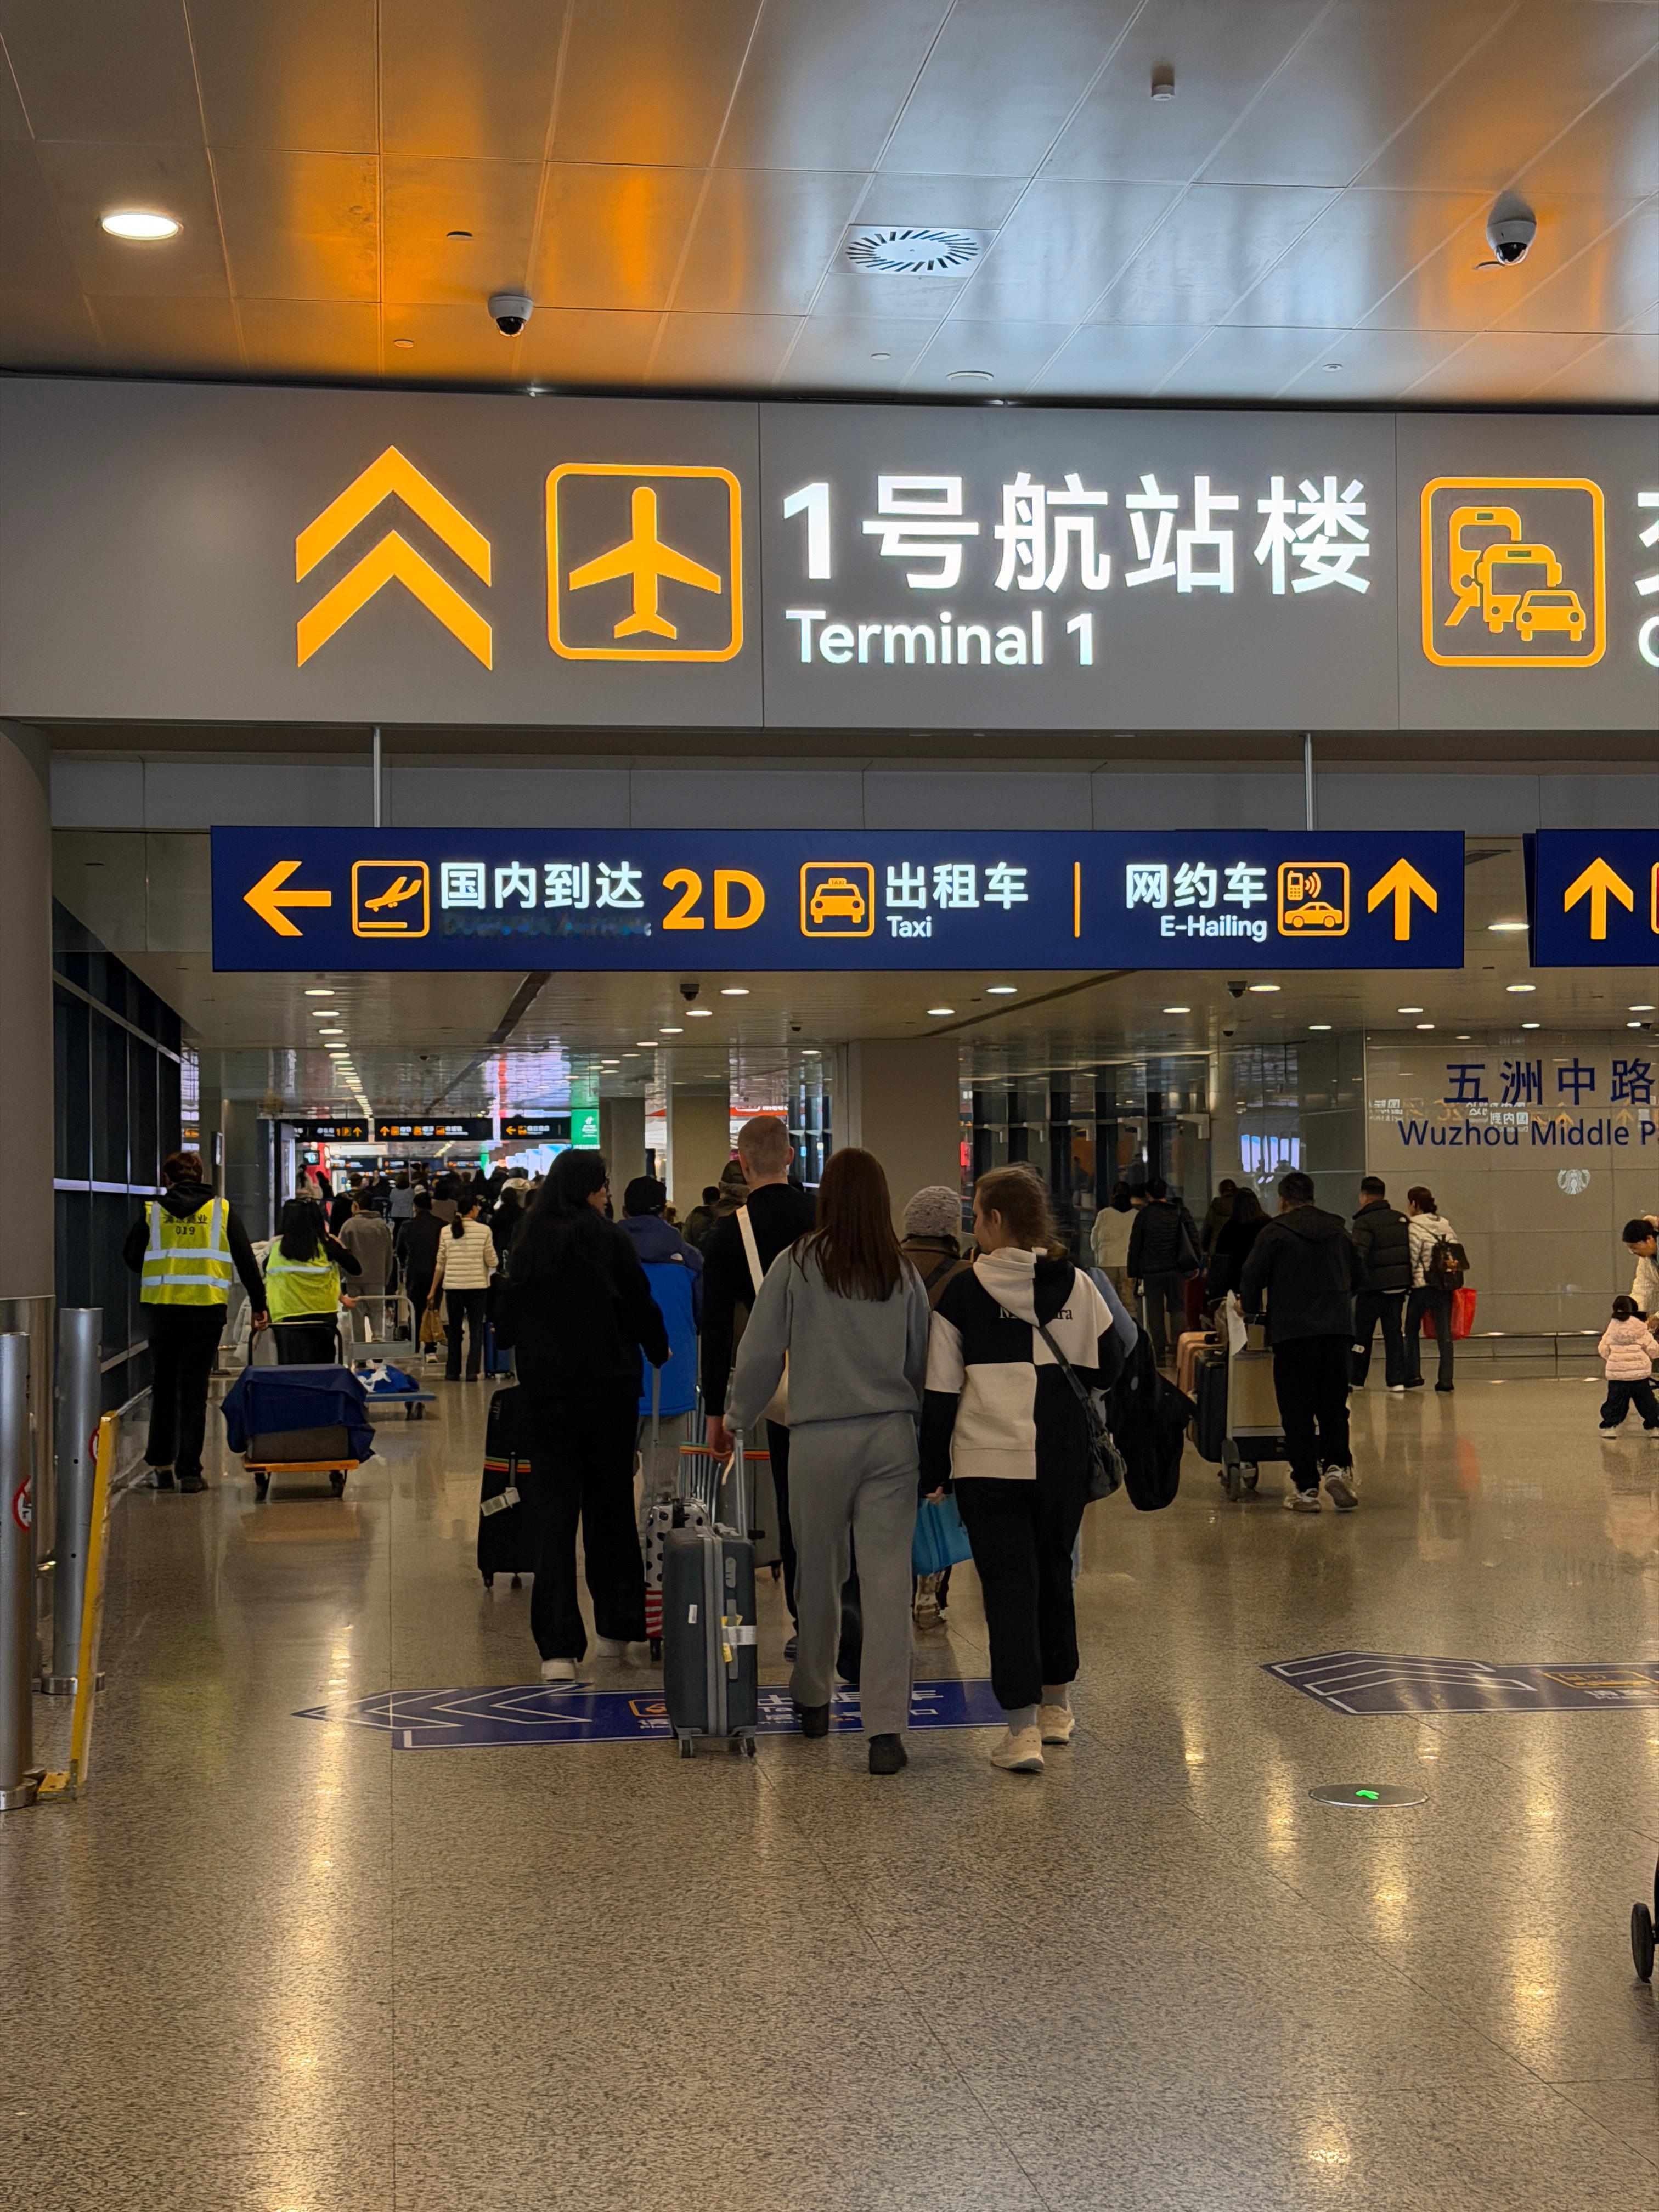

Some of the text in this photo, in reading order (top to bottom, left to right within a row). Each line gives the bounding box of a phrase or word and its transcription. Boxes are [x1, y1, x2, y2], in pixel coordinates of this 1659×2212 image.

[783, 471, 1371, 595] 1号航站楼
[785, 610, 1094, 665] Terminal 1
[441, 861, 645, 910] 国内到达
[662, 868, 765, 929] 2D
[885, 861, 1029, 910] 出租车
[1126, 861, 1268, 909] 网约车
[885, 916, 932, 938] Taxi
[1160, 914, 1267, 943] E-Hailing
[1443, 1057, 1656, 1107] 五洲中路
[1398, 1118, 1519, 1146] Wuzhou
[1531, 1118, 1629, 1146] Middle
[175, 1225, 196, 1235] 019
